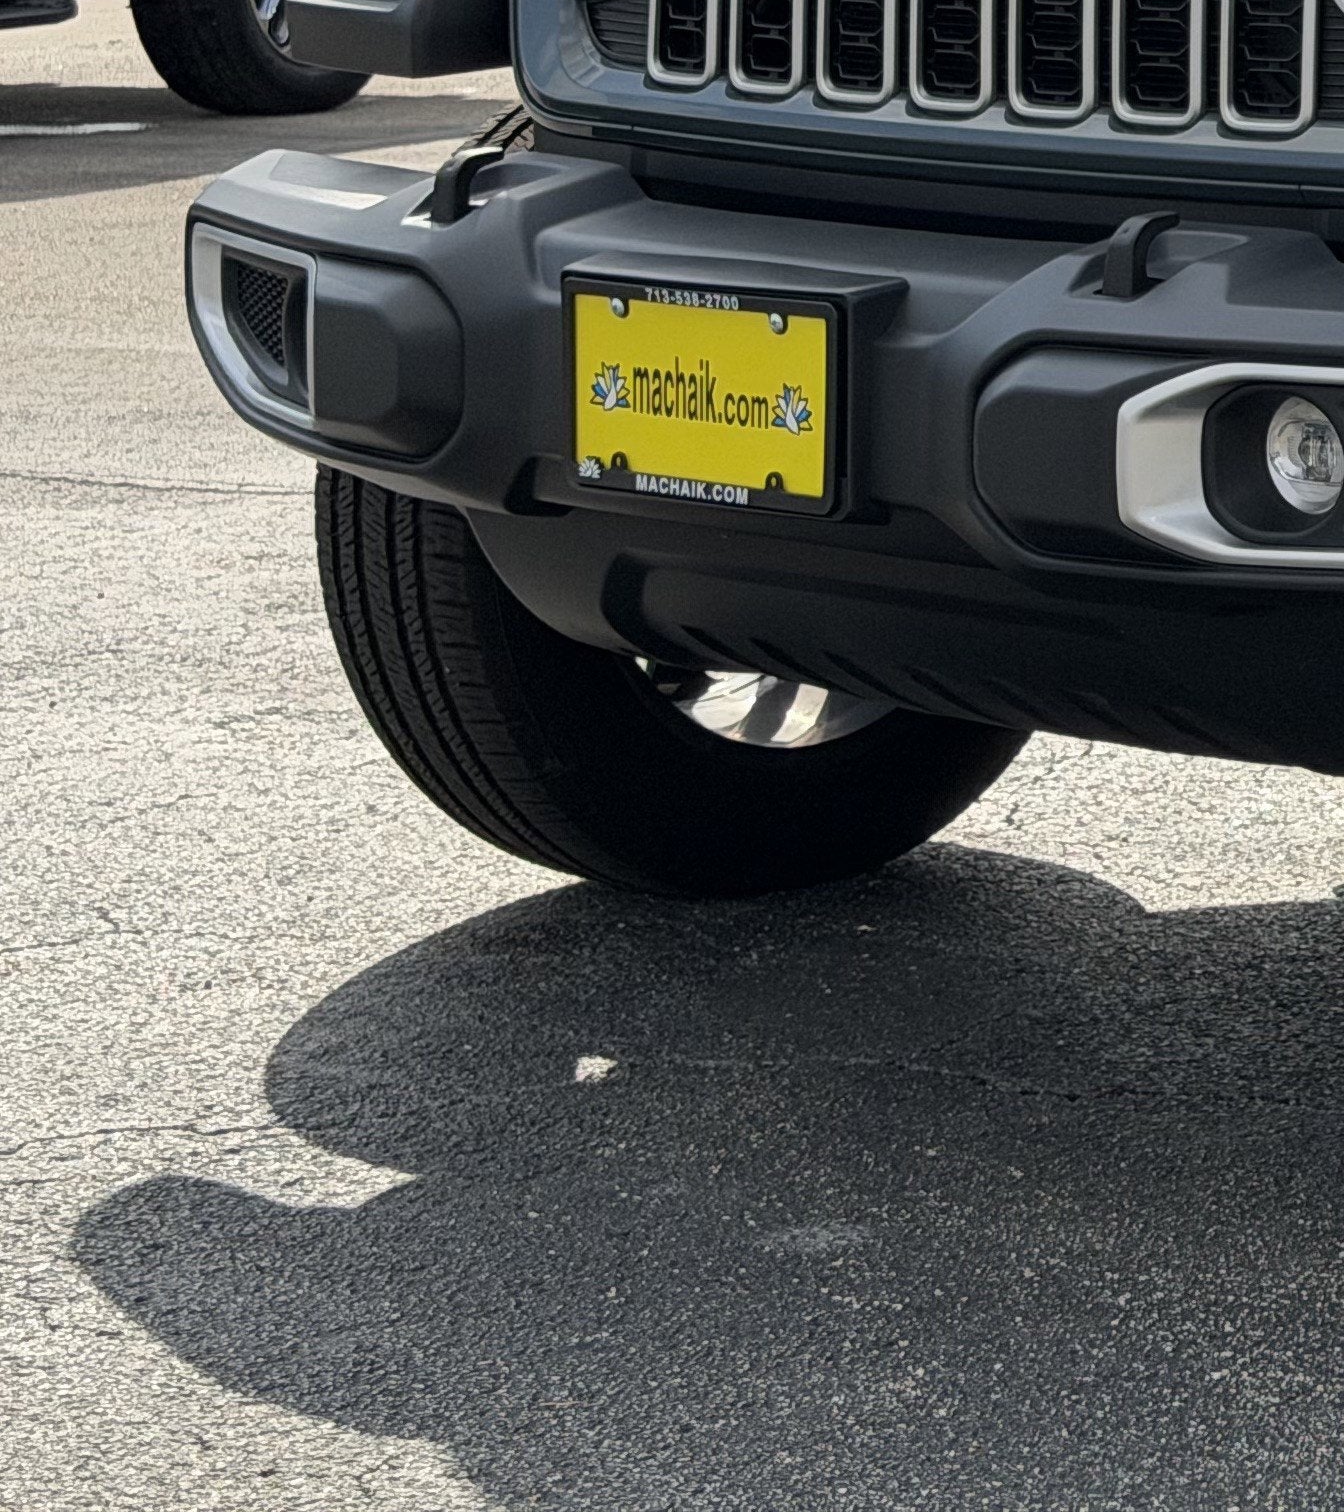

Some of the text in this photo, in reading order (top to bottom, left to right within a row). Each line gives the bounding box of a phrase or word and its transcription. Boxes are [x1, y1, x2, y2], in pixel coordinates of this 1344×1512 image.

[644, 287, 739, 311] 713-538-2700
[632, 356, 769, 429] machaik.com
[635, 474, 749, 506] MACHAIK.COM
